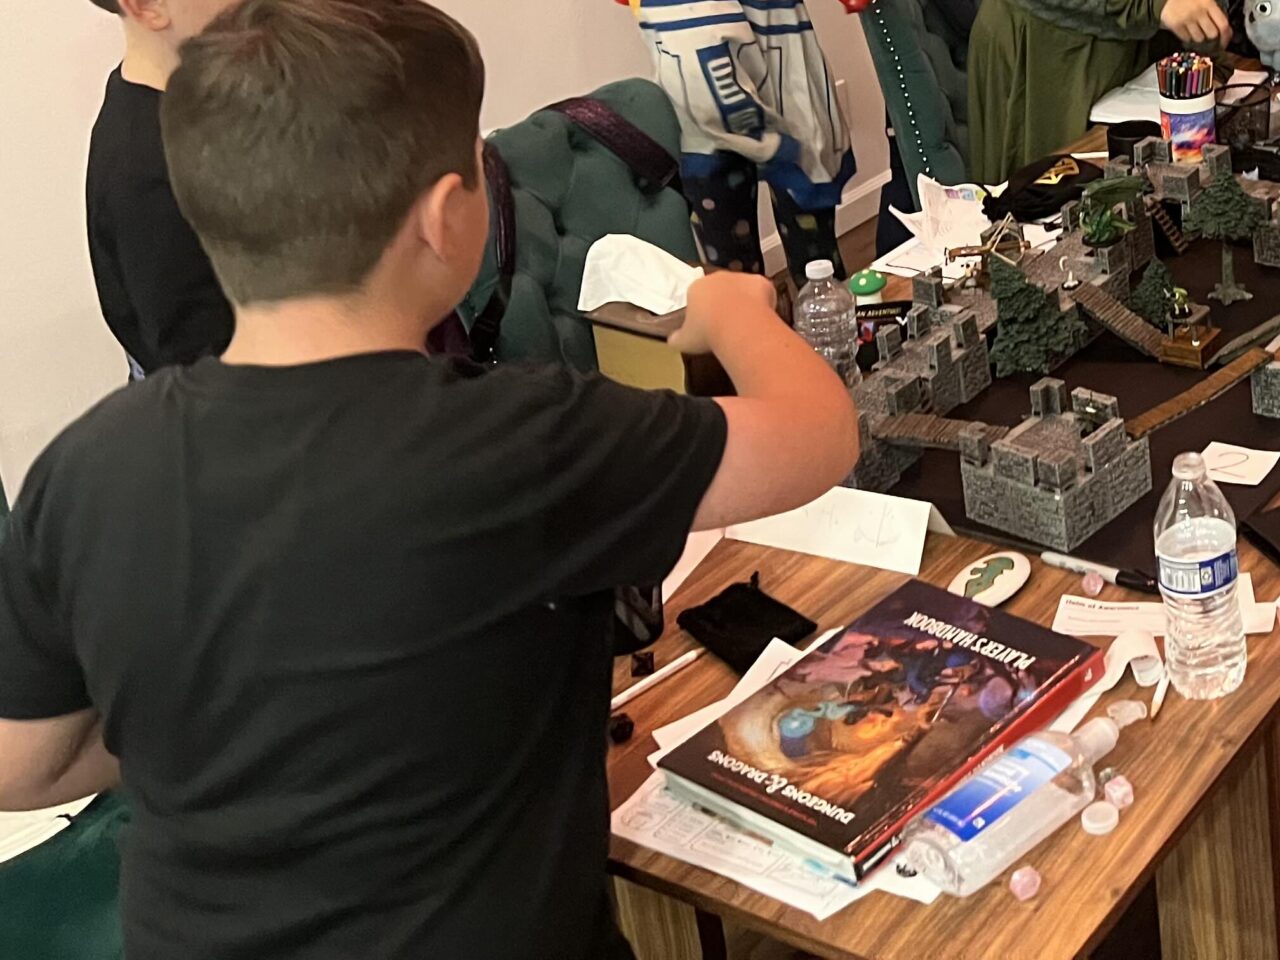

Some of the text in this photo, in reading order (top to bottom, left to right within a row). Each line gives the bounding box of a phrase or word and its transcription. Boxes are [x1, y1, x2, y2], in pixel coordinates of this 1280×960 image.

[1210, 451, 1249, 478] 2
[903, 611, 978, 648] HANDBOOK
[707, 750, 769, 783] DRAGONS
[781, 784, 856, 825] DUNGEONS
